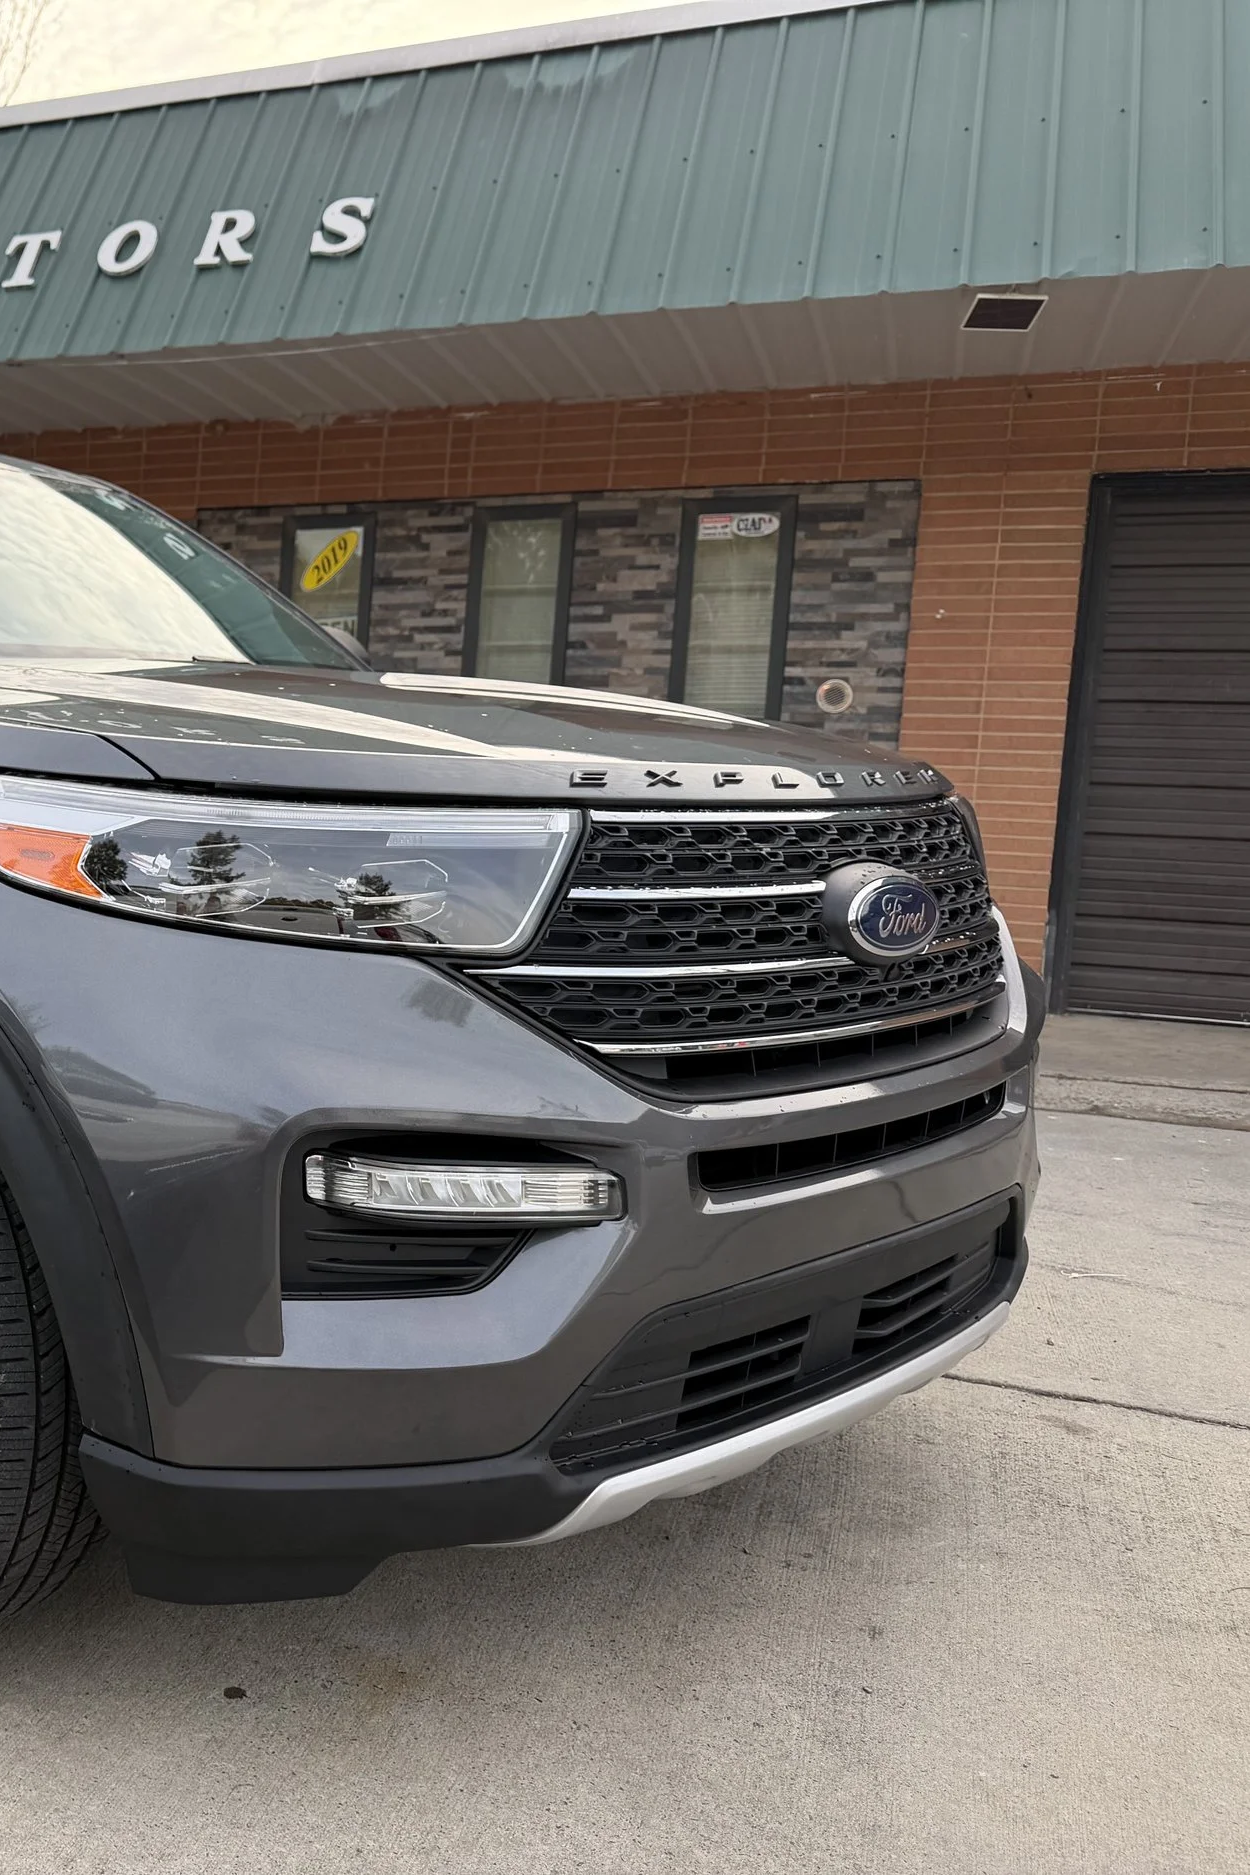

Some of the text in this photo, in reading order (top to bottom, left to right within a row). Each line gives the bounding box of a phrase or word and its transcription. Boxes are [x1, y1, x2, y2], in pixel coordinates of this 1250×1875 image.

[311, 536, 350, 585] 2019
[569, 768, 939, 789] EXPLORER
[878, 894, 929, 938] Ford
